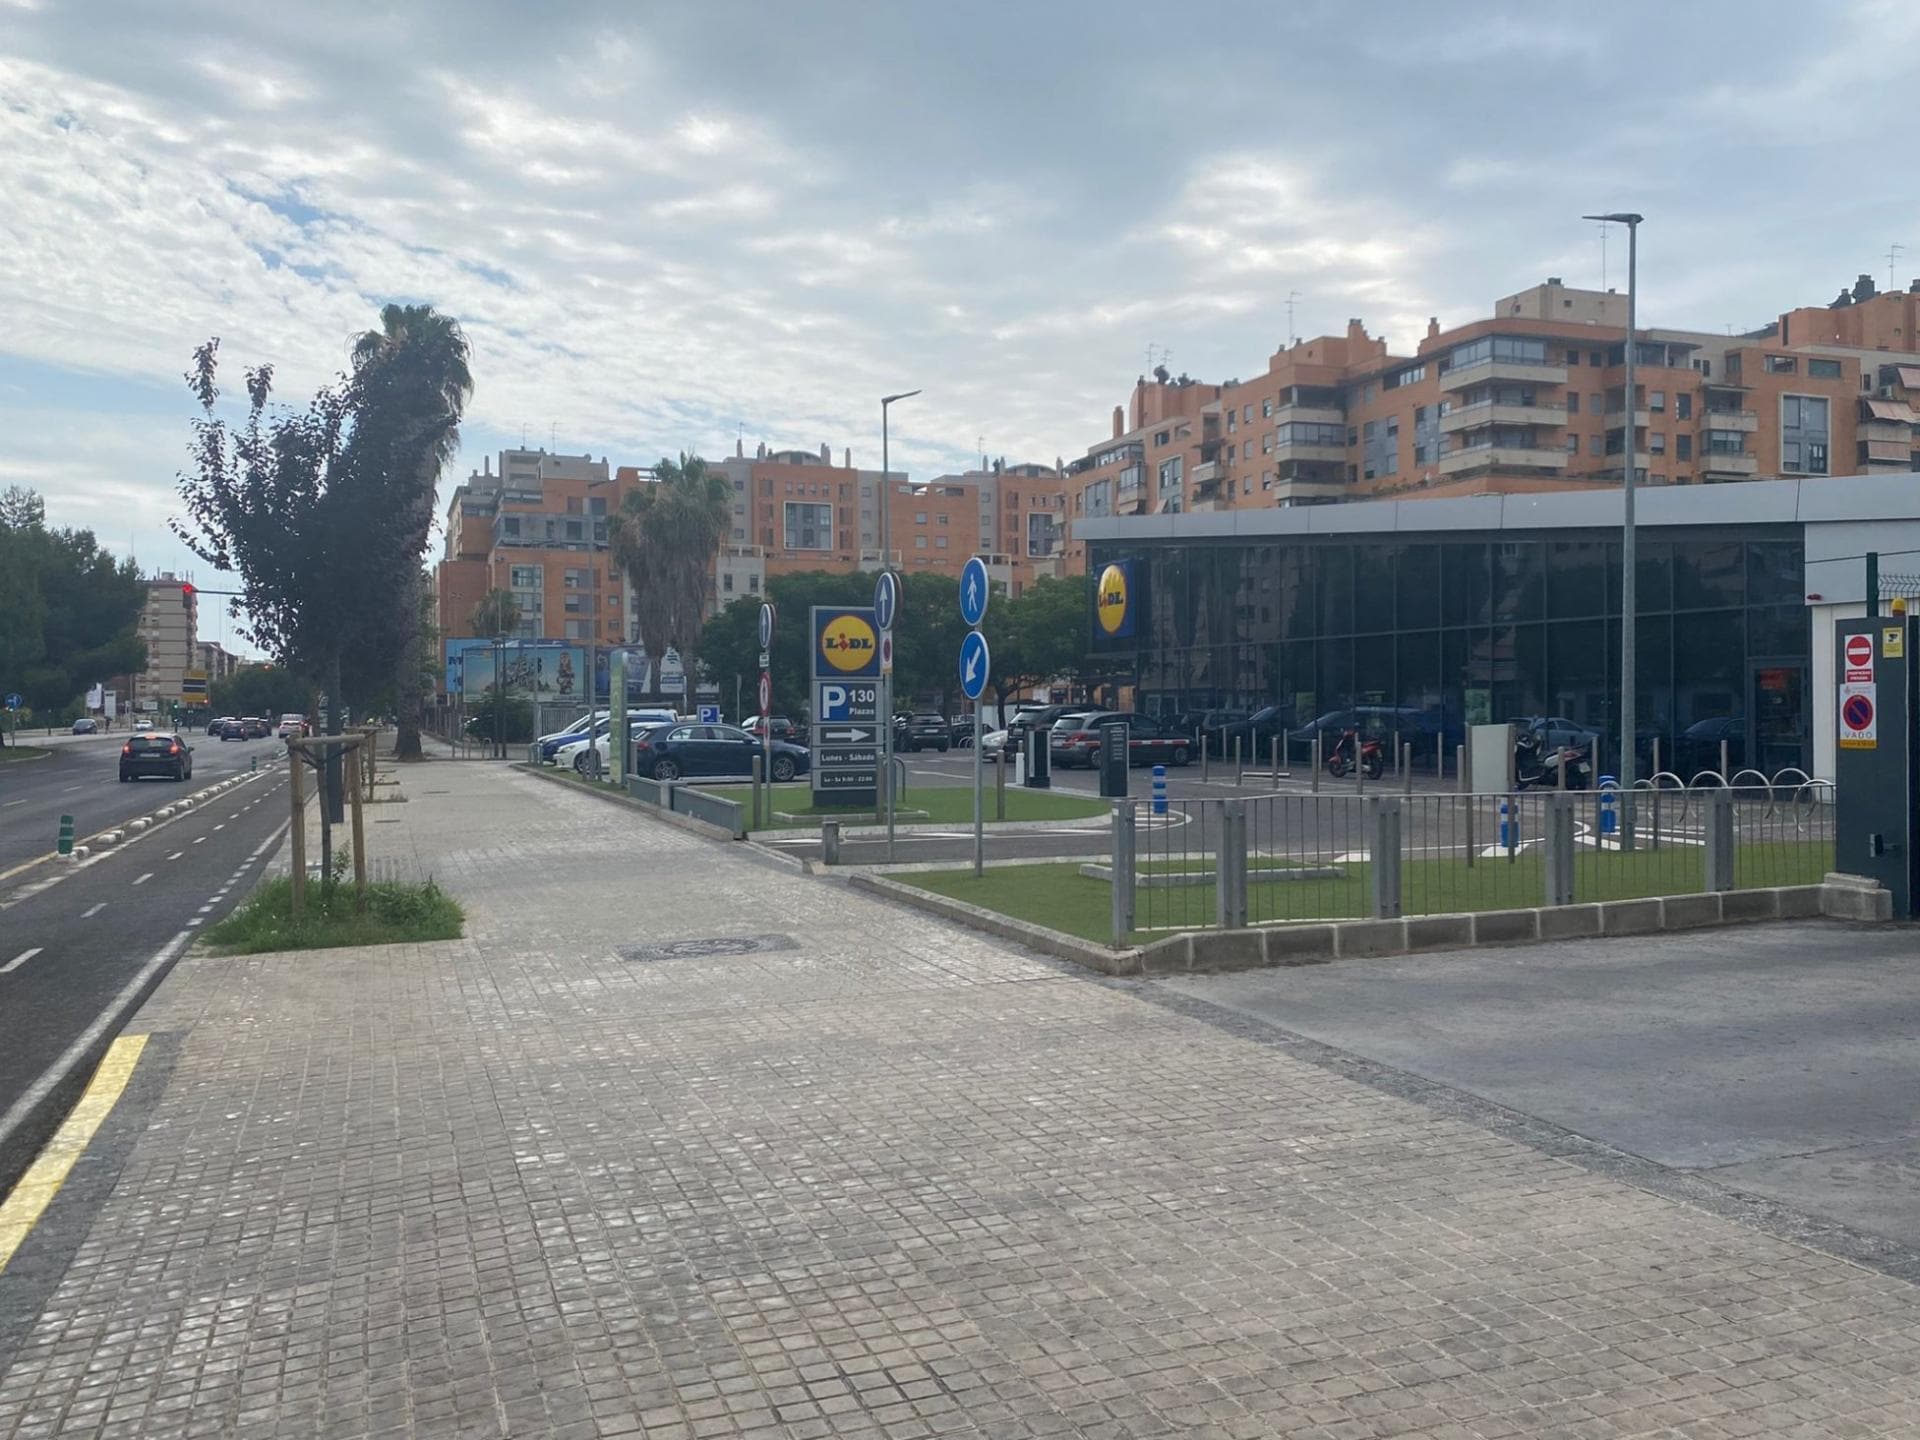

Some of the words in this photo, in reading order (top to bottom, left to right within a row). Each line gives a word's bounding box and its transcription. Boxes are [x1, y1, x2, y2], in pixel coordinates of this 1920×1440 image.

[823, 686, 846, 719] P
[849, 689, 875, 703] 130
[1845, 731, 1873, 739] VADO
[822, 754, 842, 762] Lunes
